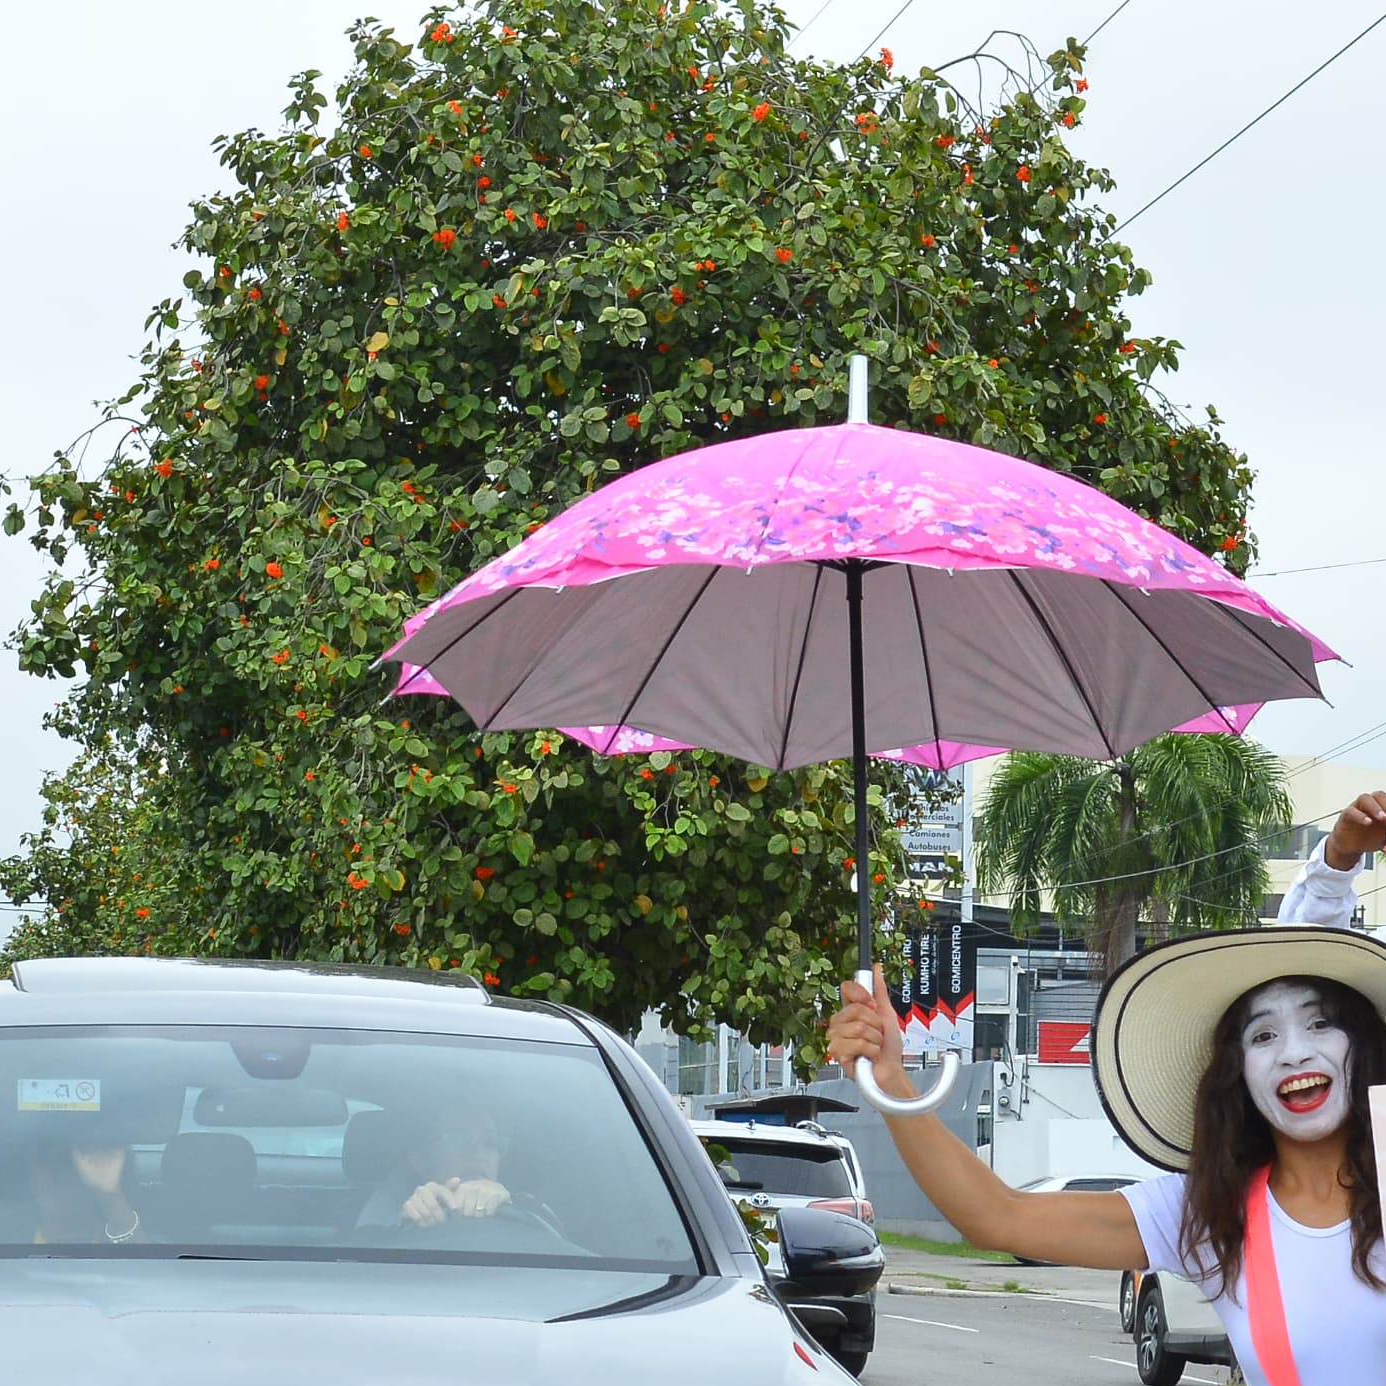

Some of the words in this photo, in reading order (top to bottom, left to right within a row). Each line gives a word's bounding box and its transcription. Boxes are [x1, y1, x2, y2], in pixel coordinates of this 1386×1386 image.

[920, 933, 930, 956] TIRE
[951, 925, 961, 994] GOMICENTRO
[920, 957, 930, 995] KUMHO
